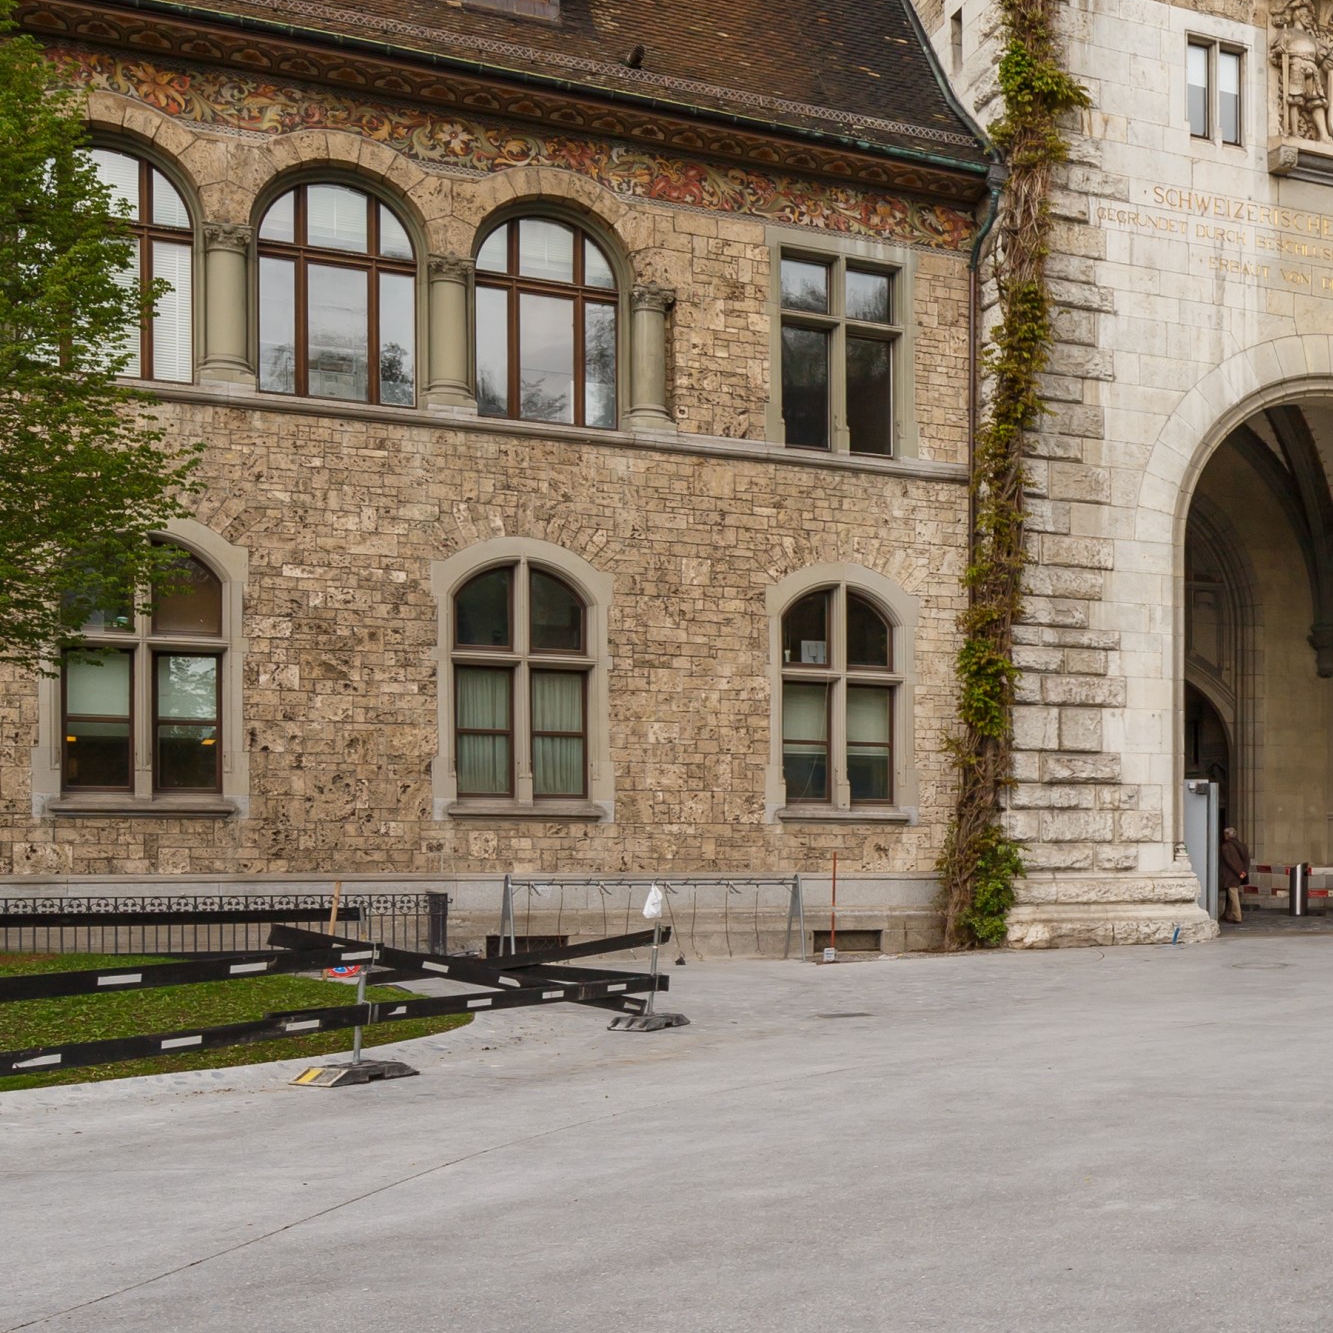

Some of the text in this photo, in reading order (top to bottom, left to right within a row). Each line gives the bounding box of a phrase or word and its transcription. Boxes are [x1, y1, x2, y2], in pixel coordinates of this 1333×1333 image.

[1196, 223, 1247, 245] DURCH
[1208, 256, 1270, 278] ERBAUT
[1280, 267, 1311, 286] VON
